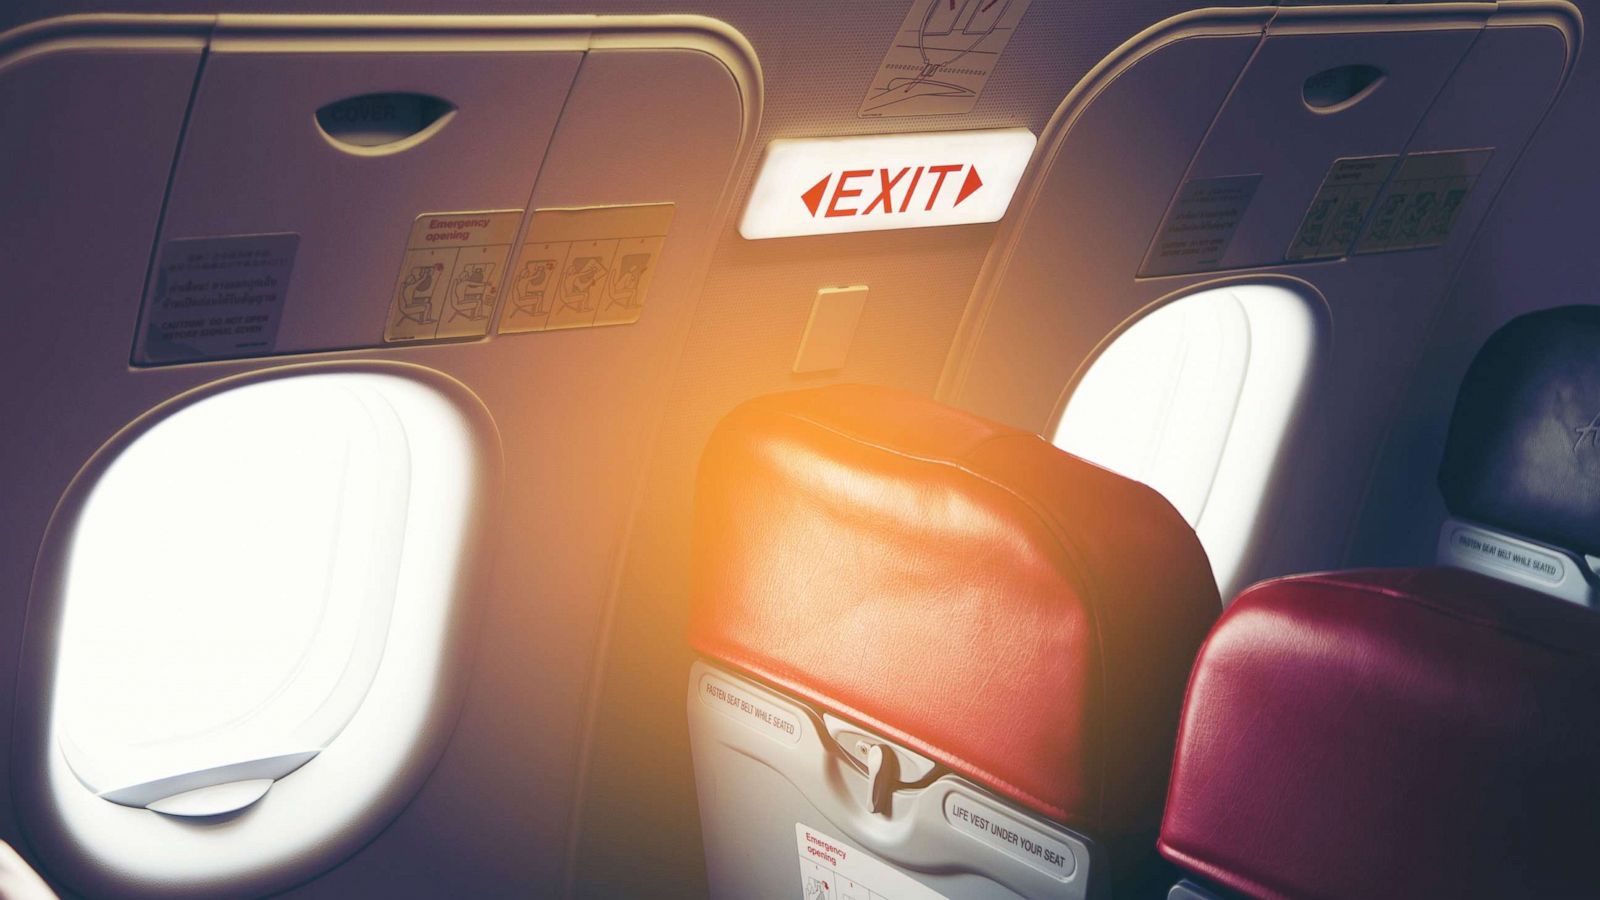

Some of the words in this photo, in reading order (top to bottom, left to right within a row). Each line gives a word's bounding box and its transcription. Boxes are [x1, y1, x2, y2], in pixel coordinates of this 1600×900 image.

[824, 164, 964, 218] EXIT
[425, 231, 470, 242] opening
[429, 217, 490, 229] Emergency
[1481, 542, 1497, 556] SEAT
[1497, 547, 1512, 560] BELT
[1513, 553, 1532, 566] WHILE
[1532, 559, 1556, 576] SEATED
[706, 683, 726, 701] FASTEN
[727, 693, 741, 708] SEAT
[741, 700, 754, 714] BELT
[755, 706, 772, 724] WHILE
[772, 716, 795, 735] SEATED
[805, 832, 847, 860] Emergency
[952, 804, 969, 821] LIFE
[970, 813, 990, 831] VEST
[991, 823, 1019, 845] UNDER
[1020, 836, 1043, 857] YOUR
[1044, 849, 1066, 868] SEAT
[807, 846, 837, 866] opening
